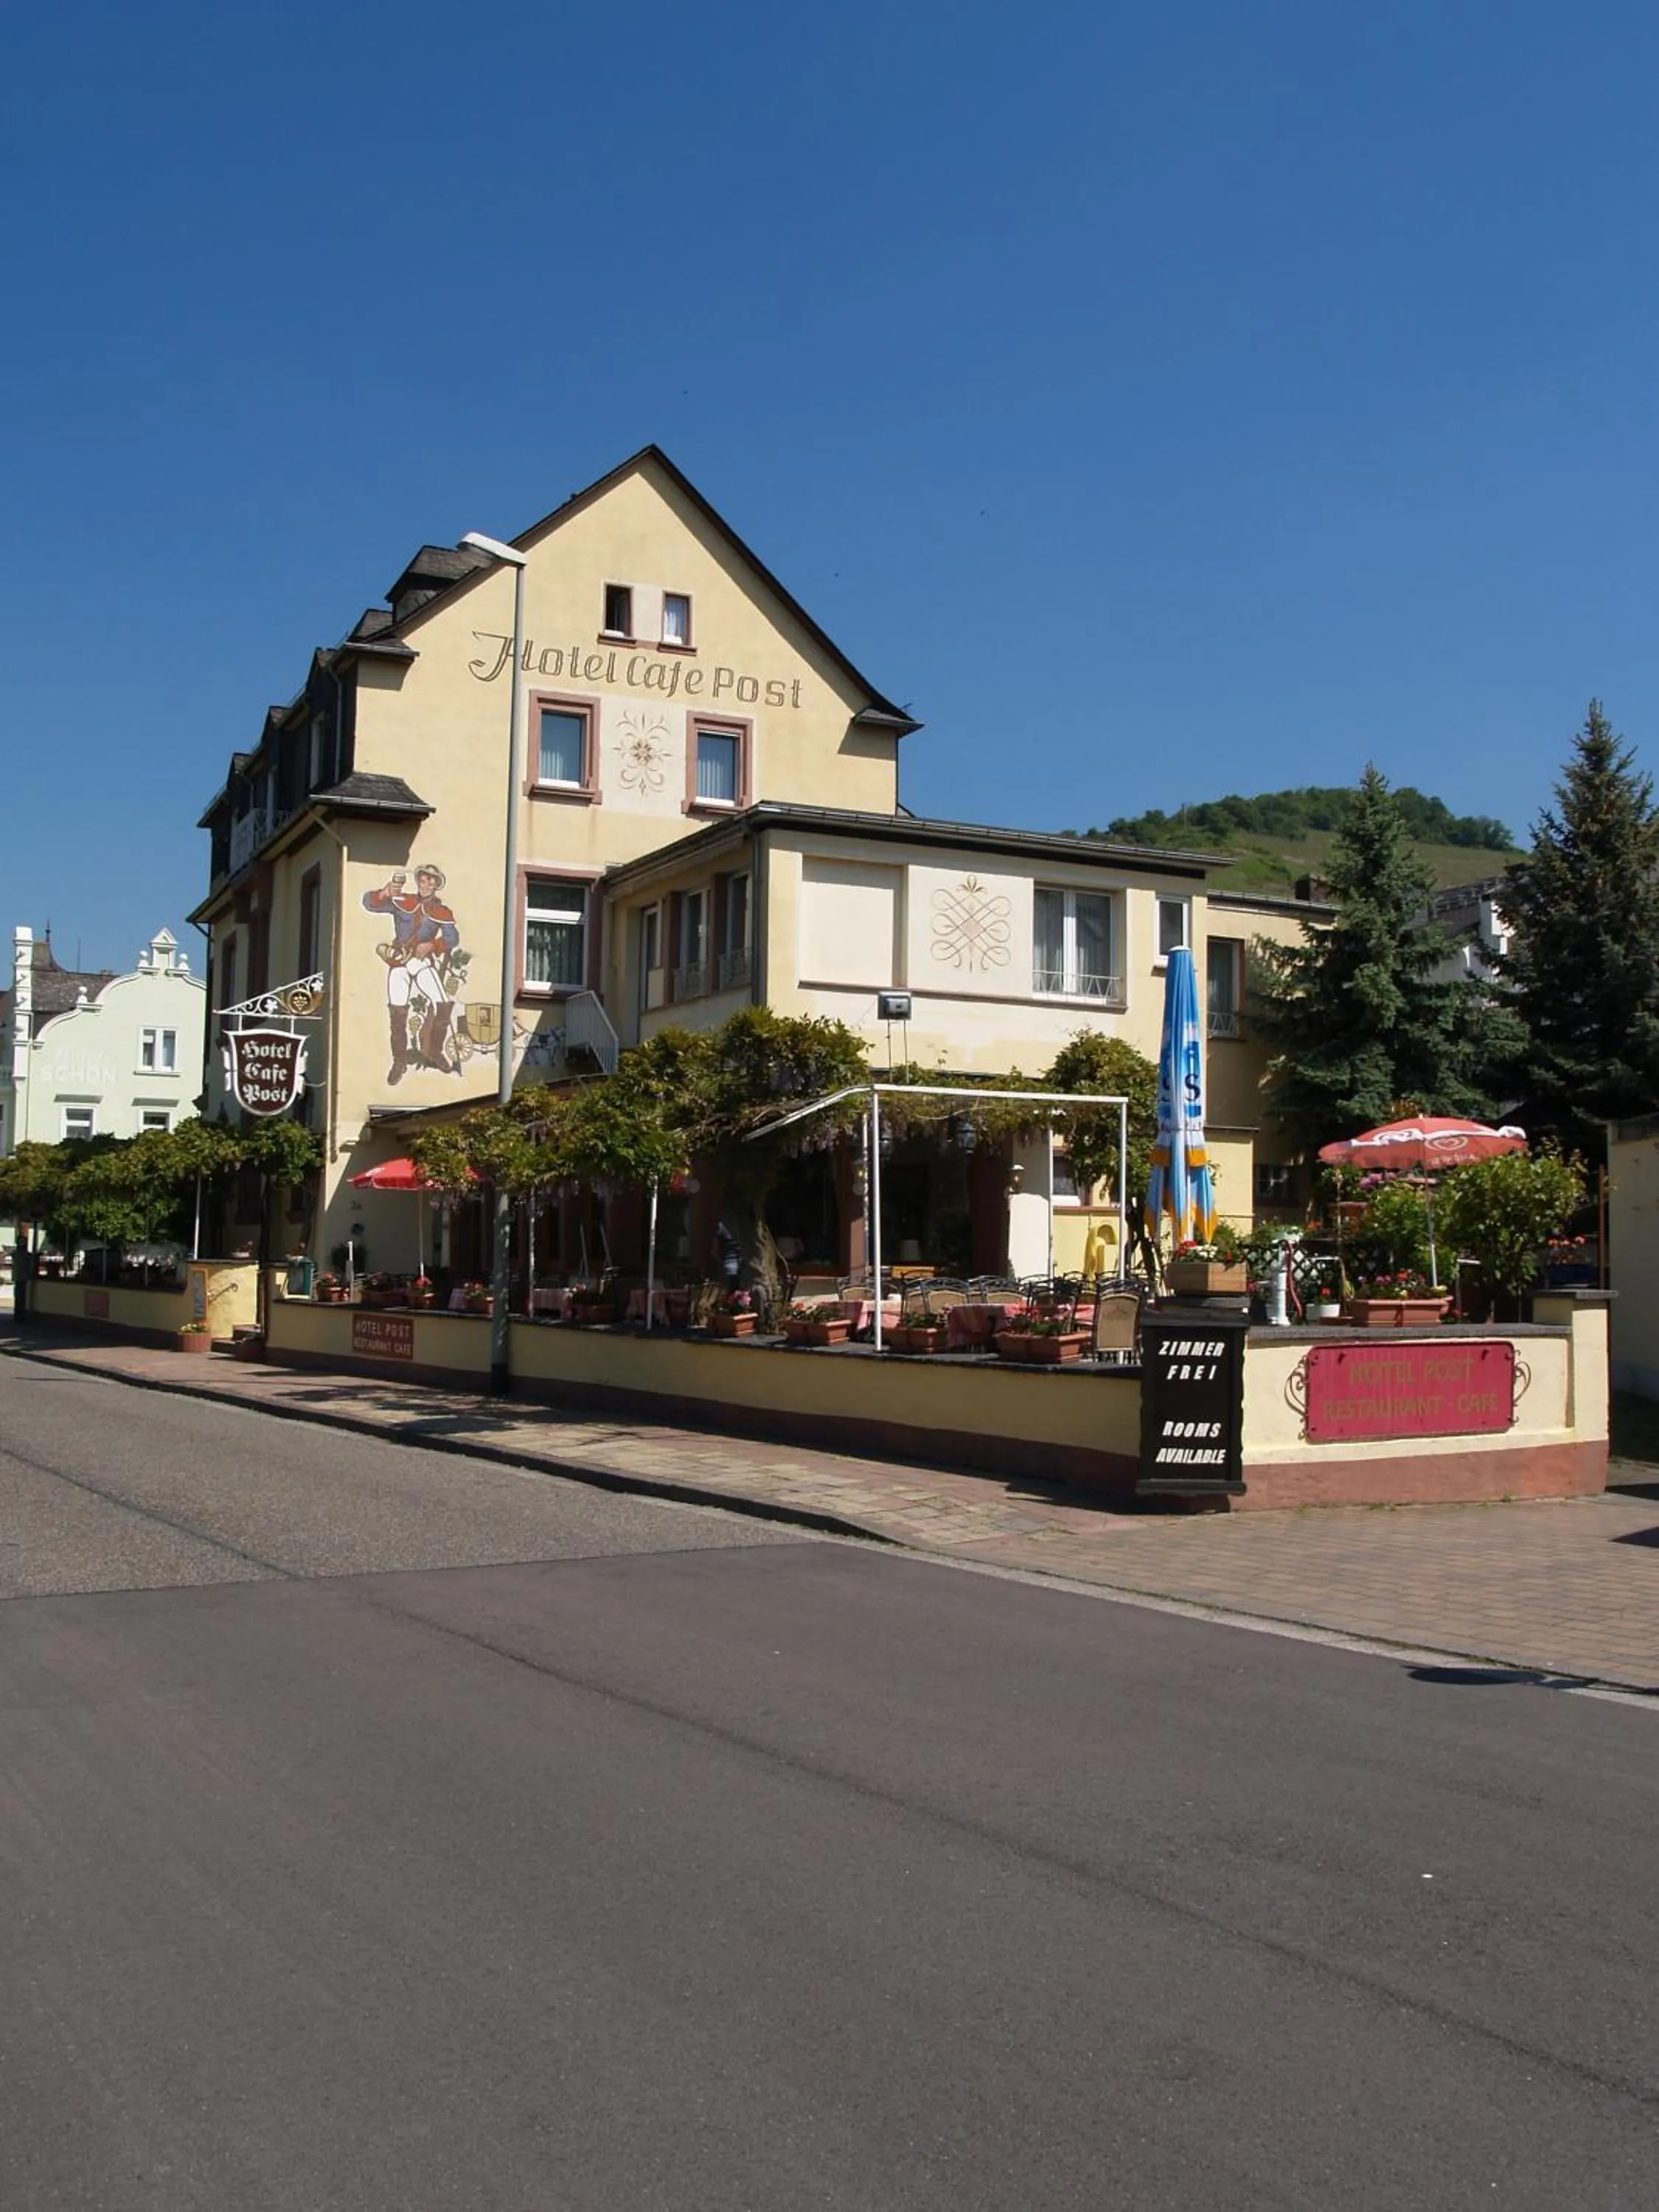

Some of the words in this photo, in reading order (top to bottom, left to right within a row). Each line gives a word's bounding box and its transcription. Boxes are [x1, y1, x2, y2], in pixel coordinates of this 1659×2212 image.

[468, 630, 616, 683] Hotel
[627, 655, 703, 698] Cafe
[712, 667, 803, 709] Post
[241, 1040, 292, 1059] Hotel
[244, 1062, 288, 1085] Cafe
[243, 1083, 288, 1105] Post
[355, 1321, 381, 1335] HOTEL
[386, 1323, 411, 1338] POST
[1158, 1340, 1225, 1357] ZIMMER
[1166, 1365, 1217, 1380] FREI
[1349, 1361, 1416, 1385] HOTEL
[1424, 1357, 1474, 1381] POST
[1324, 1397, 1442, 1420] RESTAURANT
[1162, 1421, 1222, 1437] ROOMS
[1155, 1447, 1226, 1464] AVAILABLE
